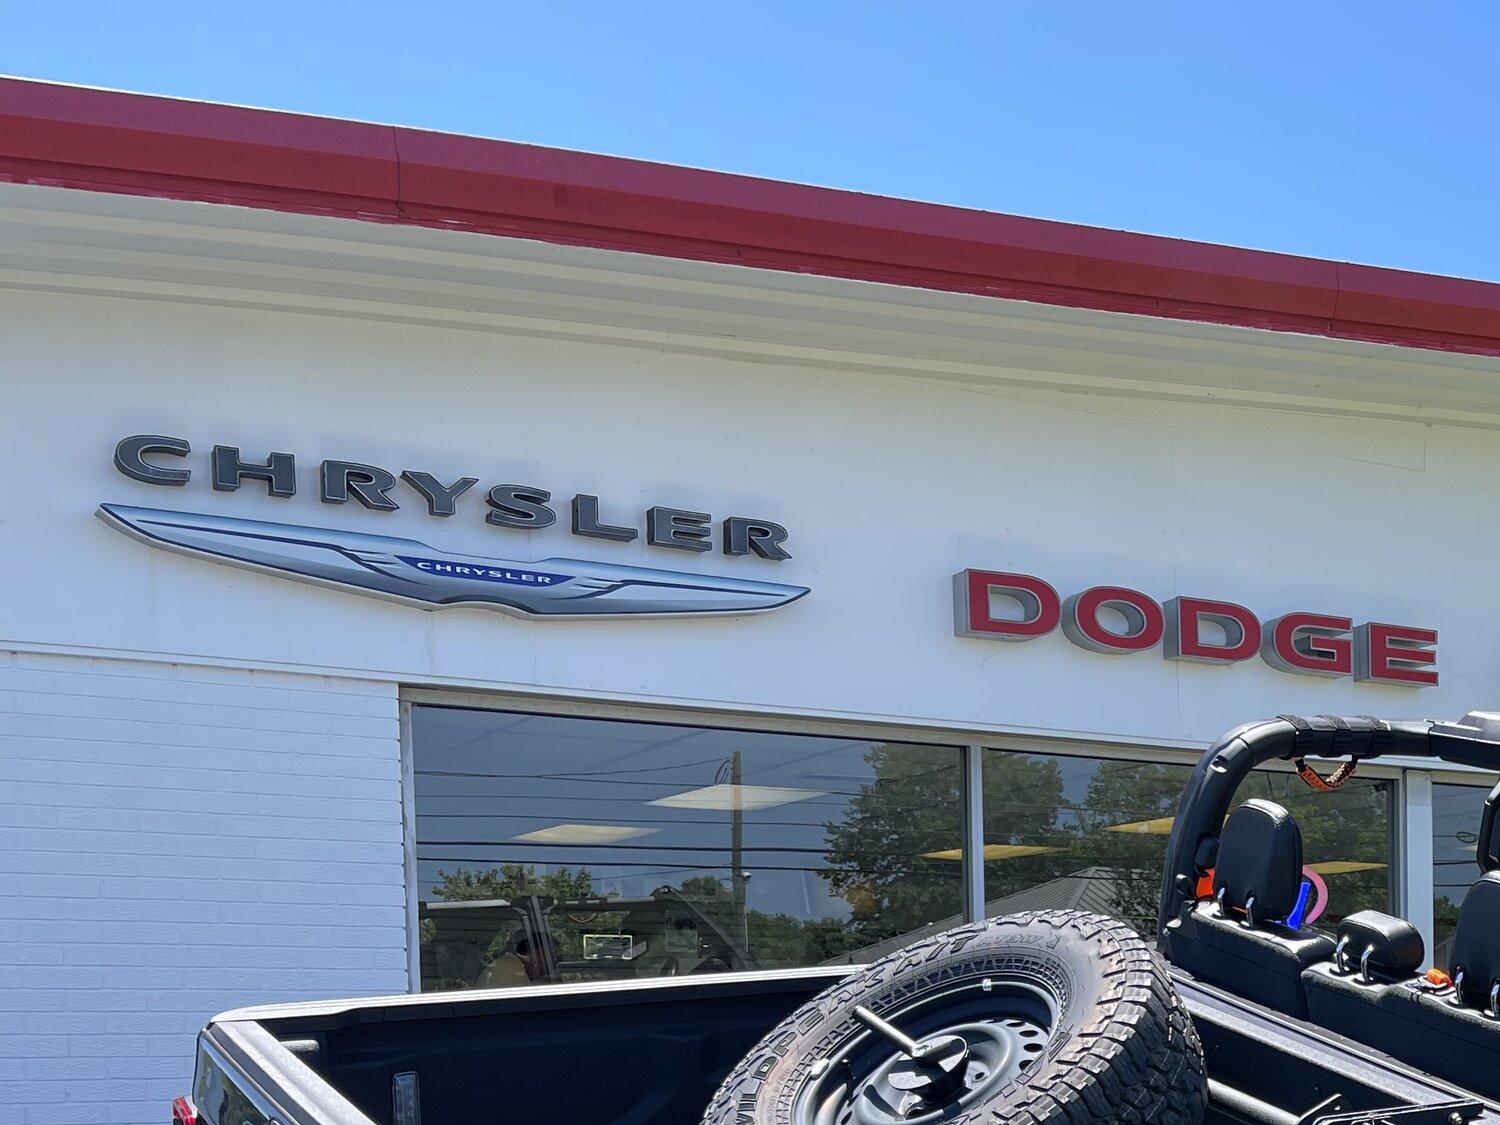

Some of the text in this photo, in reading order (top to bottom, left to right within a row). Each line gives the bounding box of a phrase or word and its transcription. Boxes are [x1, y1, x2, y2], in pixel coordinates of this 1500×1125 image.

[113, 434, 792, 561] CHRYSLER
[416, 562, 552, 585] CHRYSLER
[956, 567, 1440, 688] DODGE
